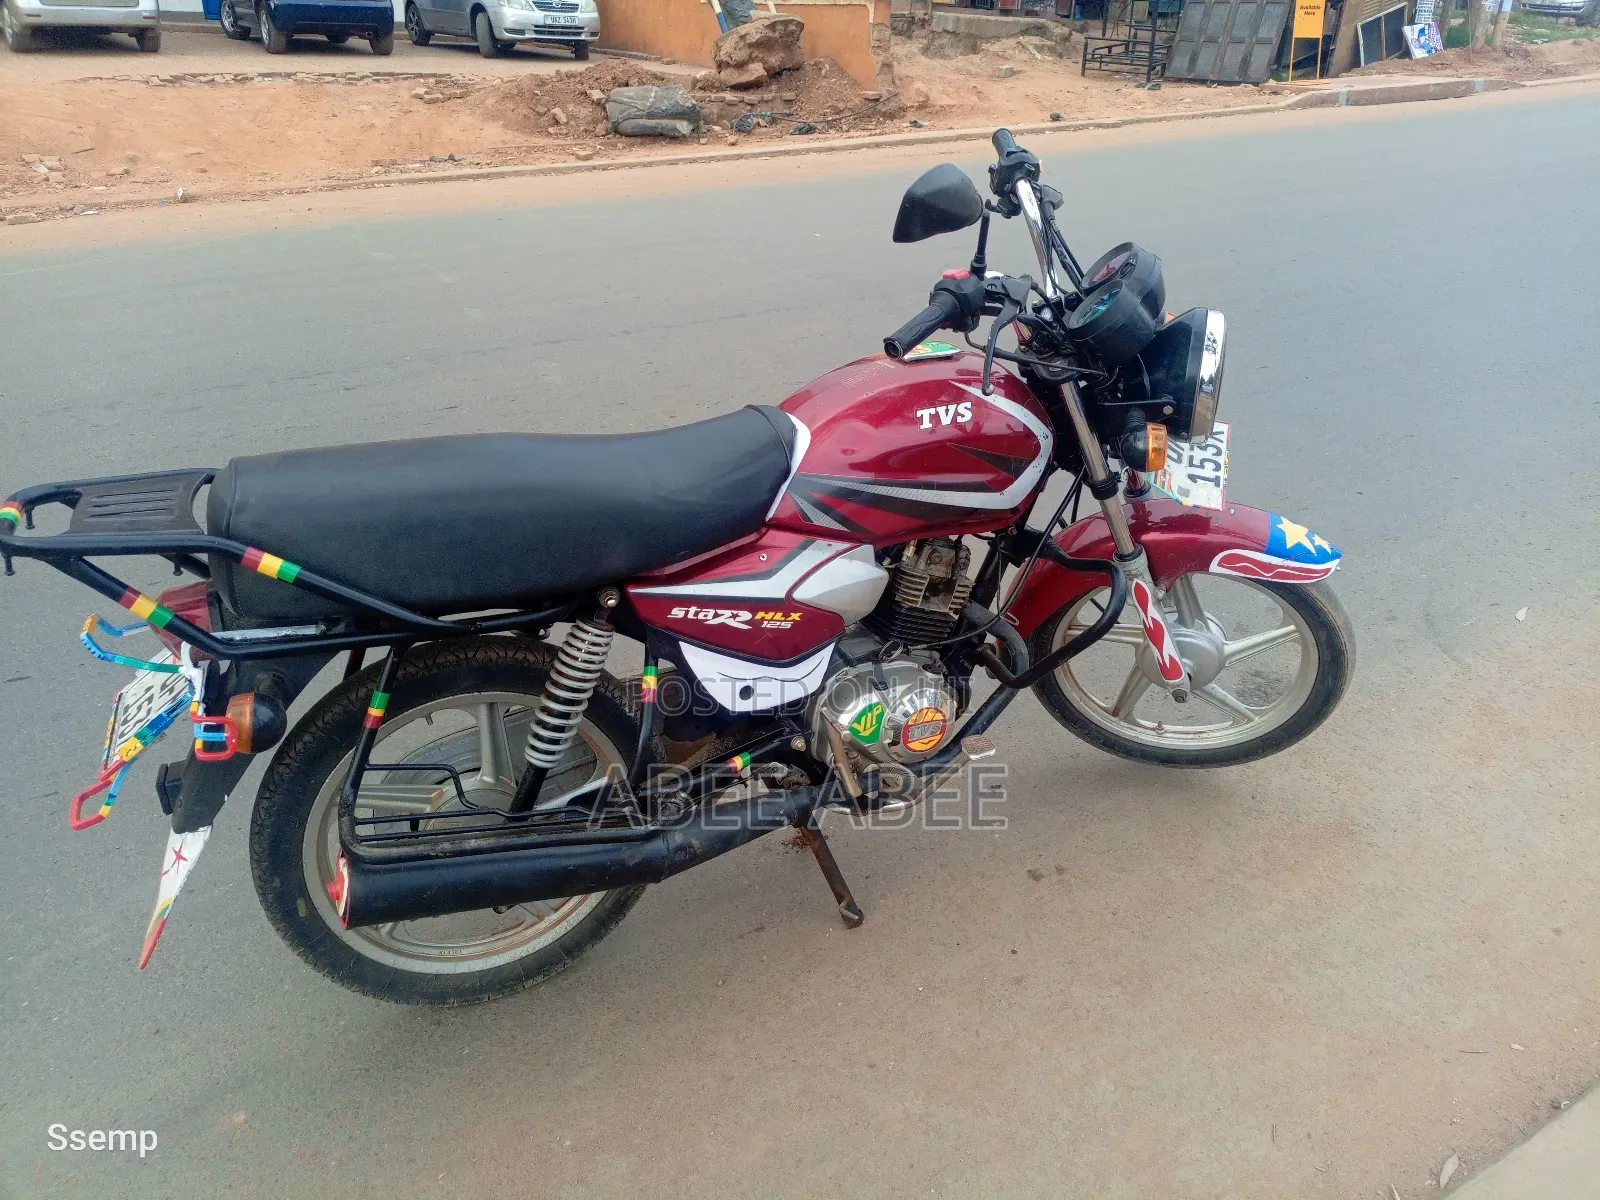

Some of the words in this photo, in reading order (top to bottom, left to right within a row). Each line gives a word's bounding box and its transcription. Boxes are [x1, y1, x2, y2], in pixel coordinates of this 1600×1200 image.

[916, 401, 973, 430] TVS
[754, 611, 803, 621] HLX
[761, 620, 793, 629] 125
[851, 704, 883, 731] VIP
[908, 721, 942, 740] TVS
